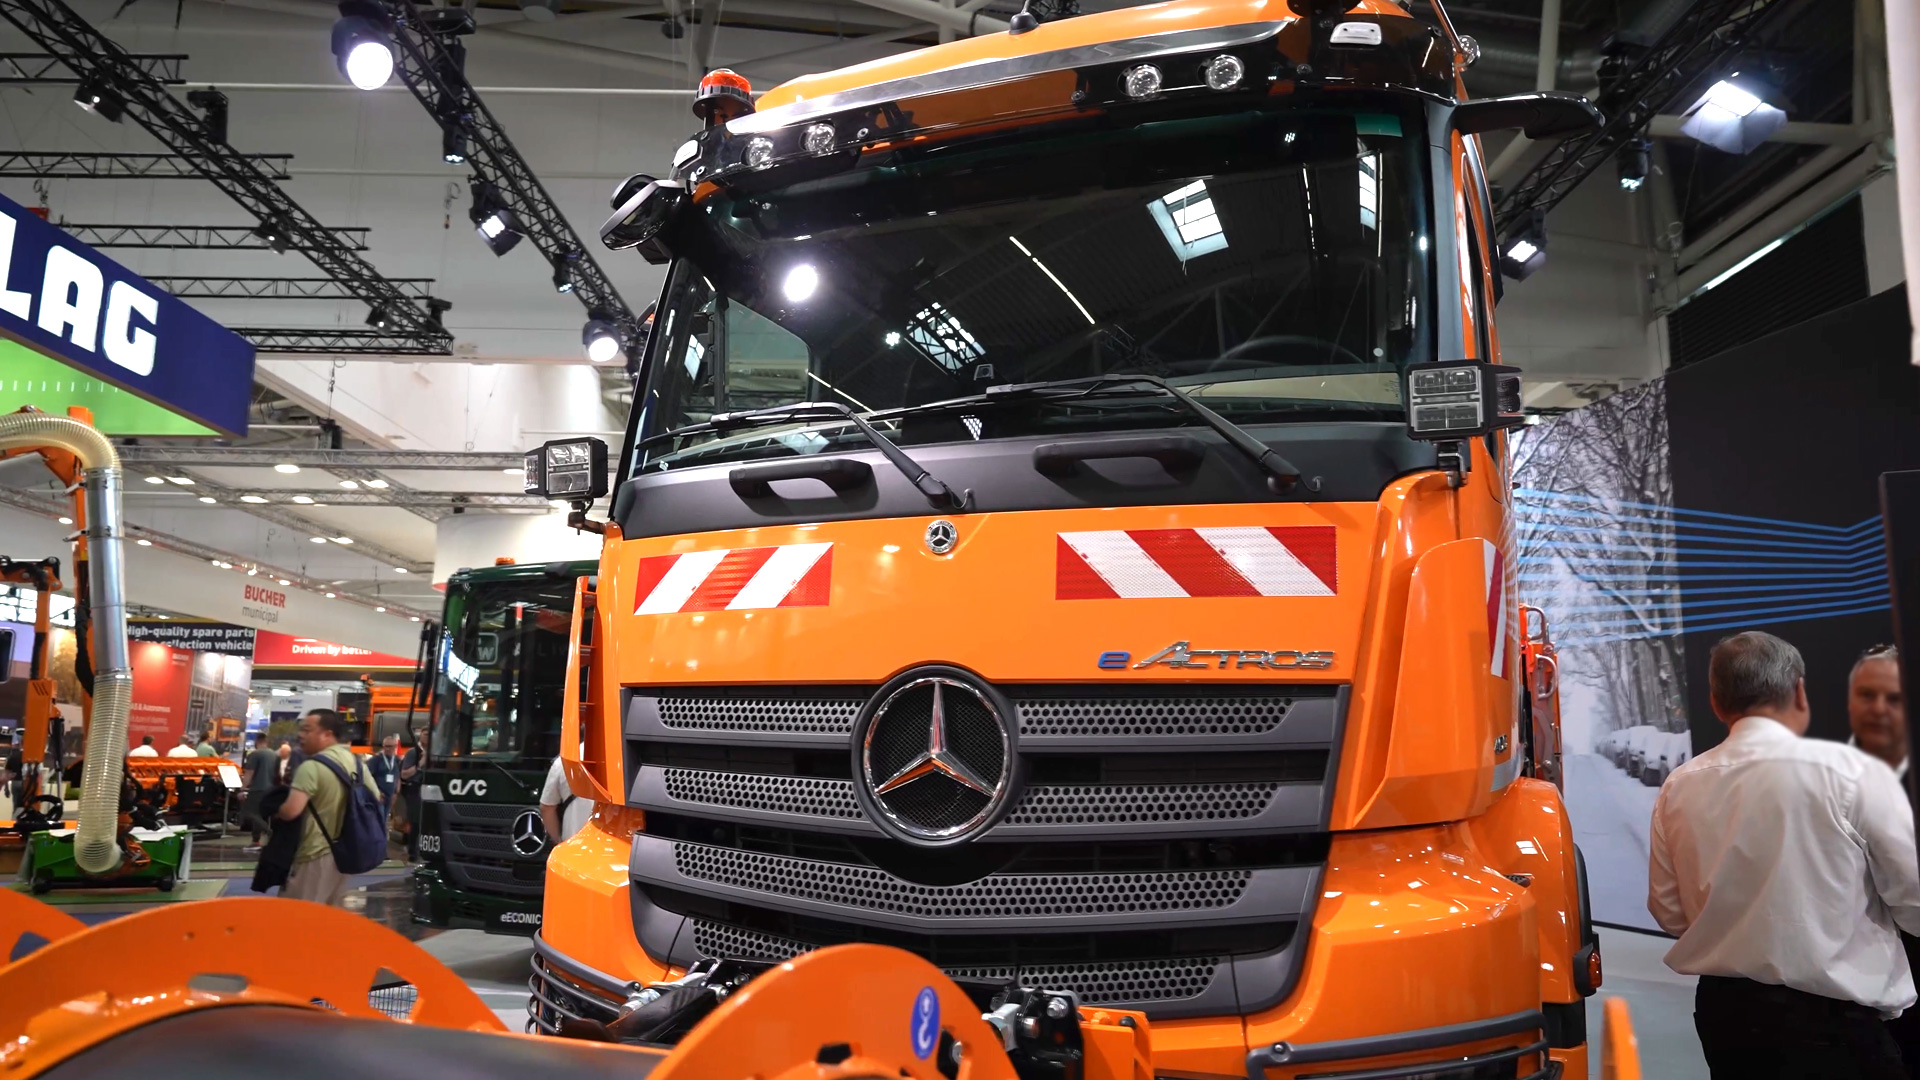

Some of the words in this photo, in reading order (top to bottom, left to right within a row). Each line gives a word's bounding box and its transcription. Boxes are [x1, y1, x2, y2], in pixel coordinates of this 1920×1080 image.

[244, 584, 286, 608] BUCHER
[241, 606, 279, 625] municipal
[192, 628, 223, 639] spare
[225, 628, 254, 639] parts
[160, 639, 212, 650] llection
[292, 644, 326, 655] Driven
[327, 644, 341, 656] by
[501, 912, 542, 925] eECONIC
